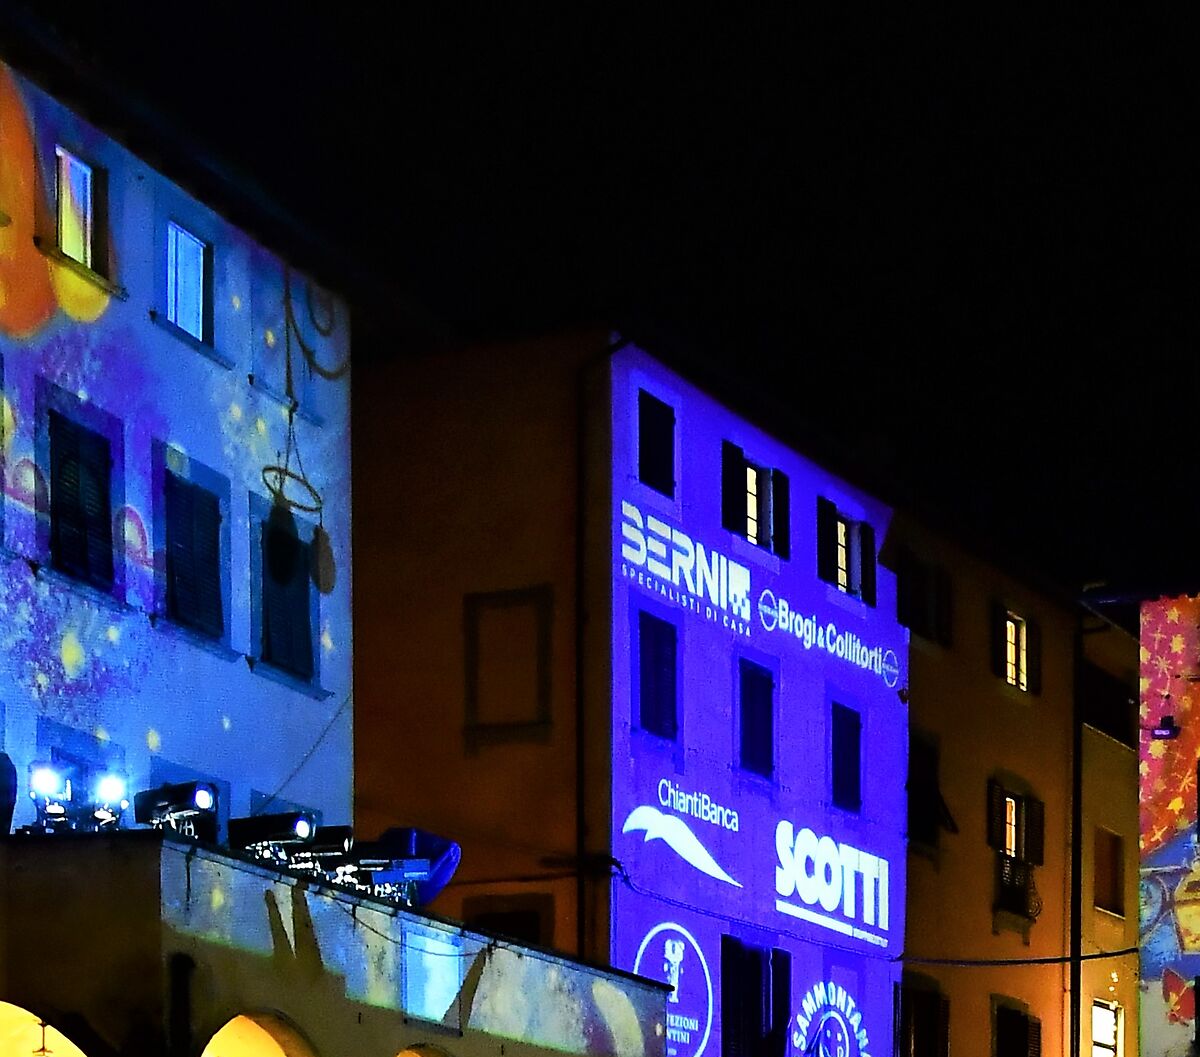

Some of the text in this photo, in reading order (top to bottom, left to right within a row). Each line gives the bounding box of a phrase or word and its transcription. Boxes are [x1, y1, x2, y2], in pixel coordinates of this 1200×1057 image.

[622, 499, 728, 611] BERNI
[622, 563, 751, 637] SPECIALISTI DI CASA
[658, 779, 739, 832] ChiantiBanca
[775, 820, 889, 931] SCOTTI
